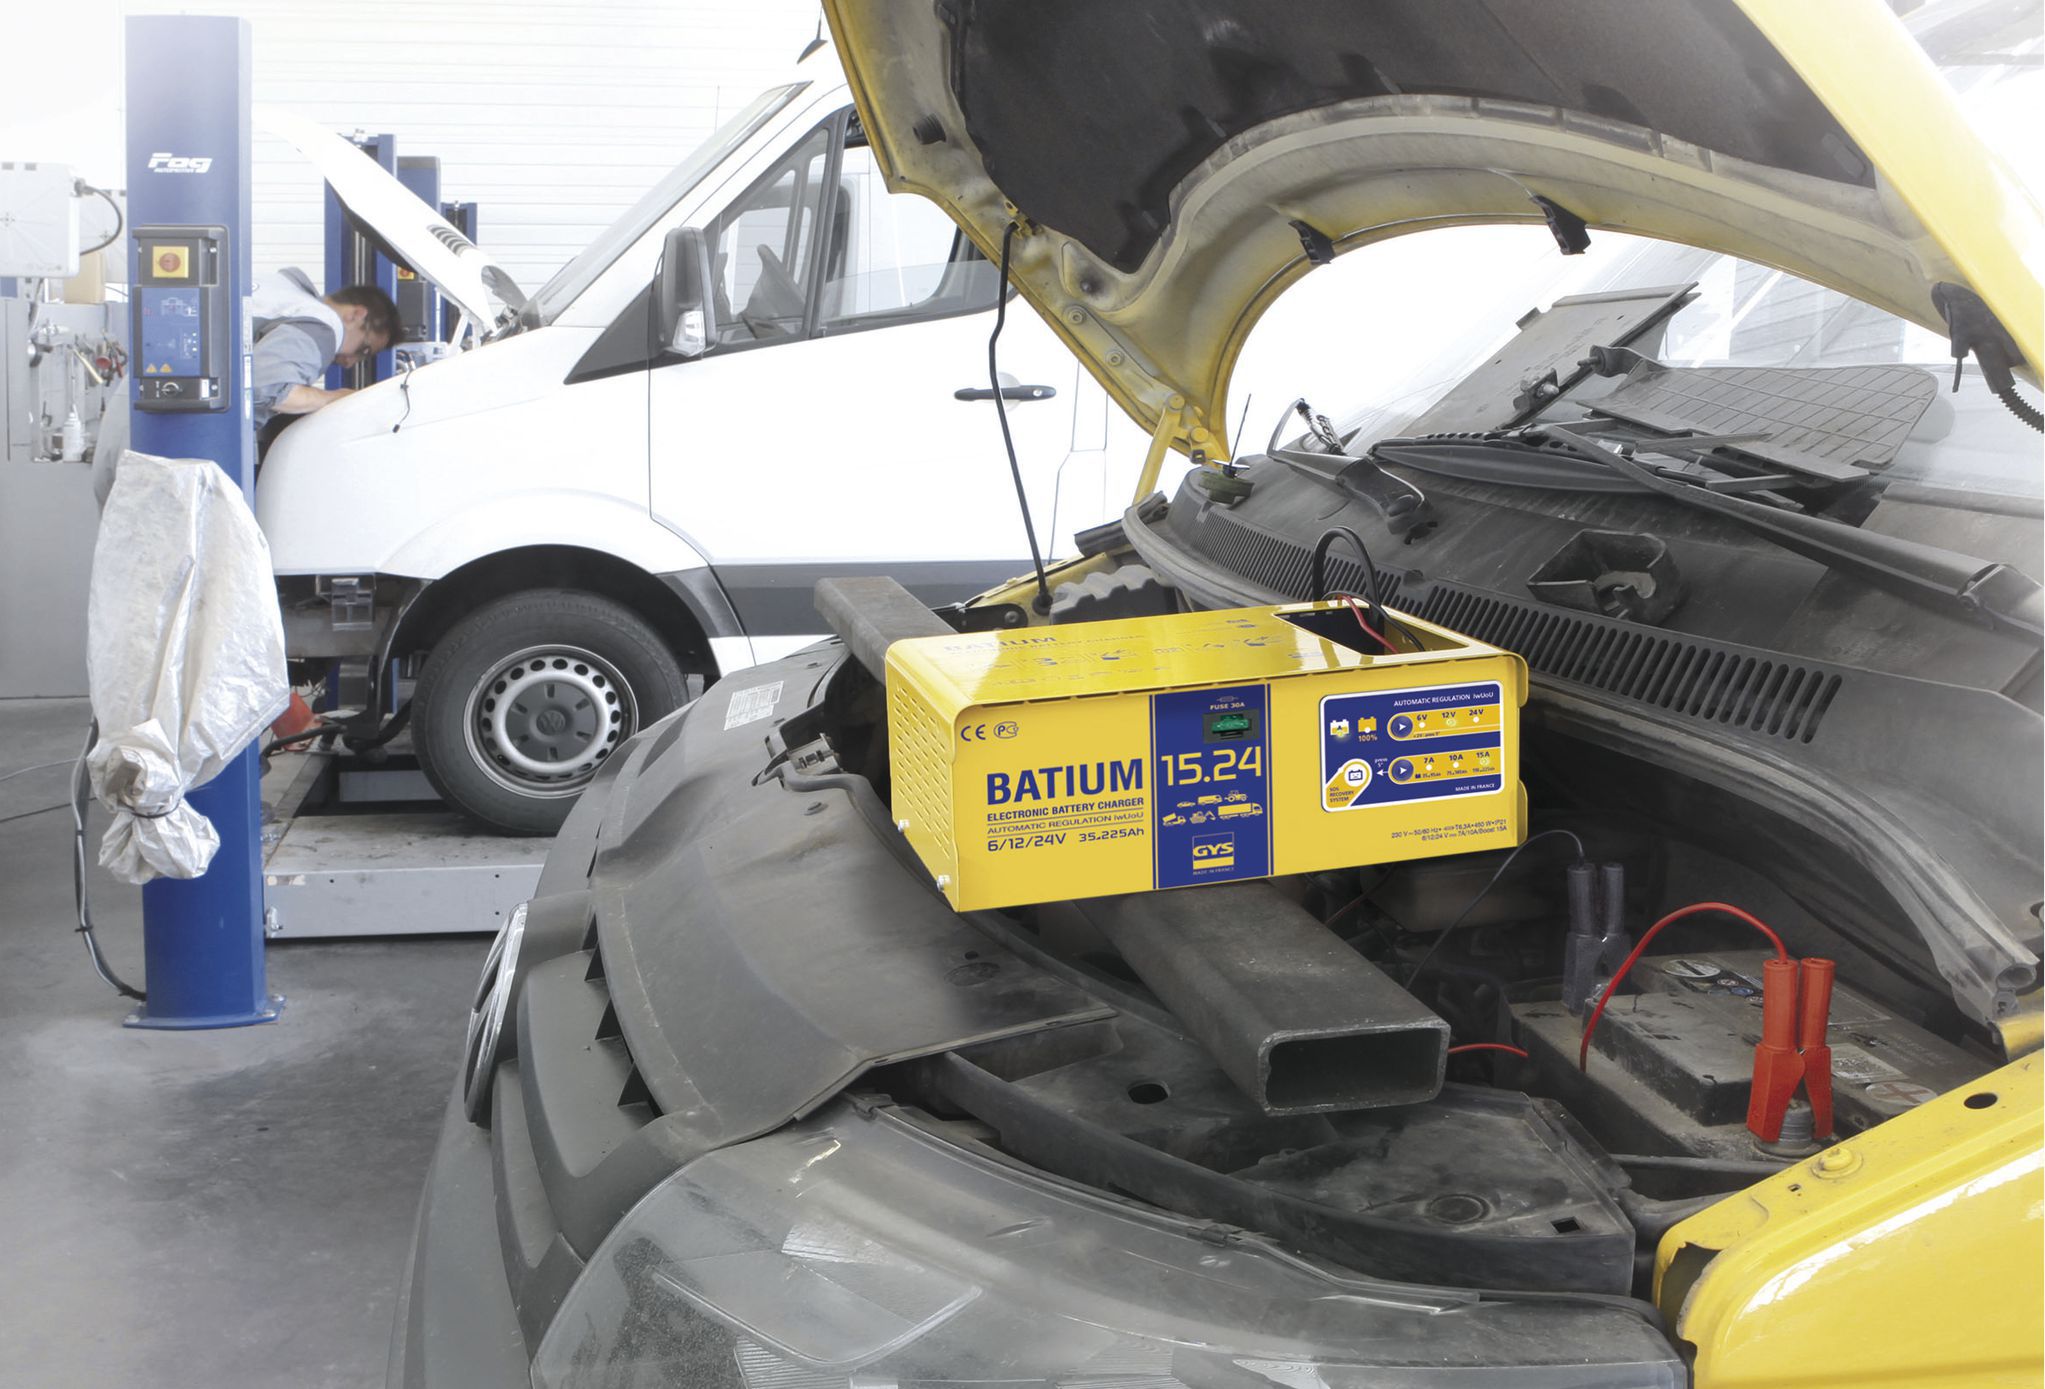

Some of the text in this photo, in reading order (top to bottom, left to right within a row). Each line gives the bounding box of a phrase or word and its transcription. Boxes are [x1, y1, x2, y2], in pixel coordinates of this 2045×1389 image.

[1394, 697, 1430, 706] AUTOMATIC
[1432, 694, 1470, 703] REGULATION
[1358, 734, 1378, 742] 100%
[1161, 746, 1261, 786] 15.24
[987, 758, 1143, 805] BATIUM
[1330, 790, 1354, 798] RECOVERY
[987, 797, 1144, 822] ELECTRONIC BATTERY CHARGER
[987, 822, 1045, 834] AUTOMATIC
[1049, 815, 1111, 828] REGULATION
[987, 833, 1066, 852] 6/12/24V
[1193, 842, 1233, 857] GYS
